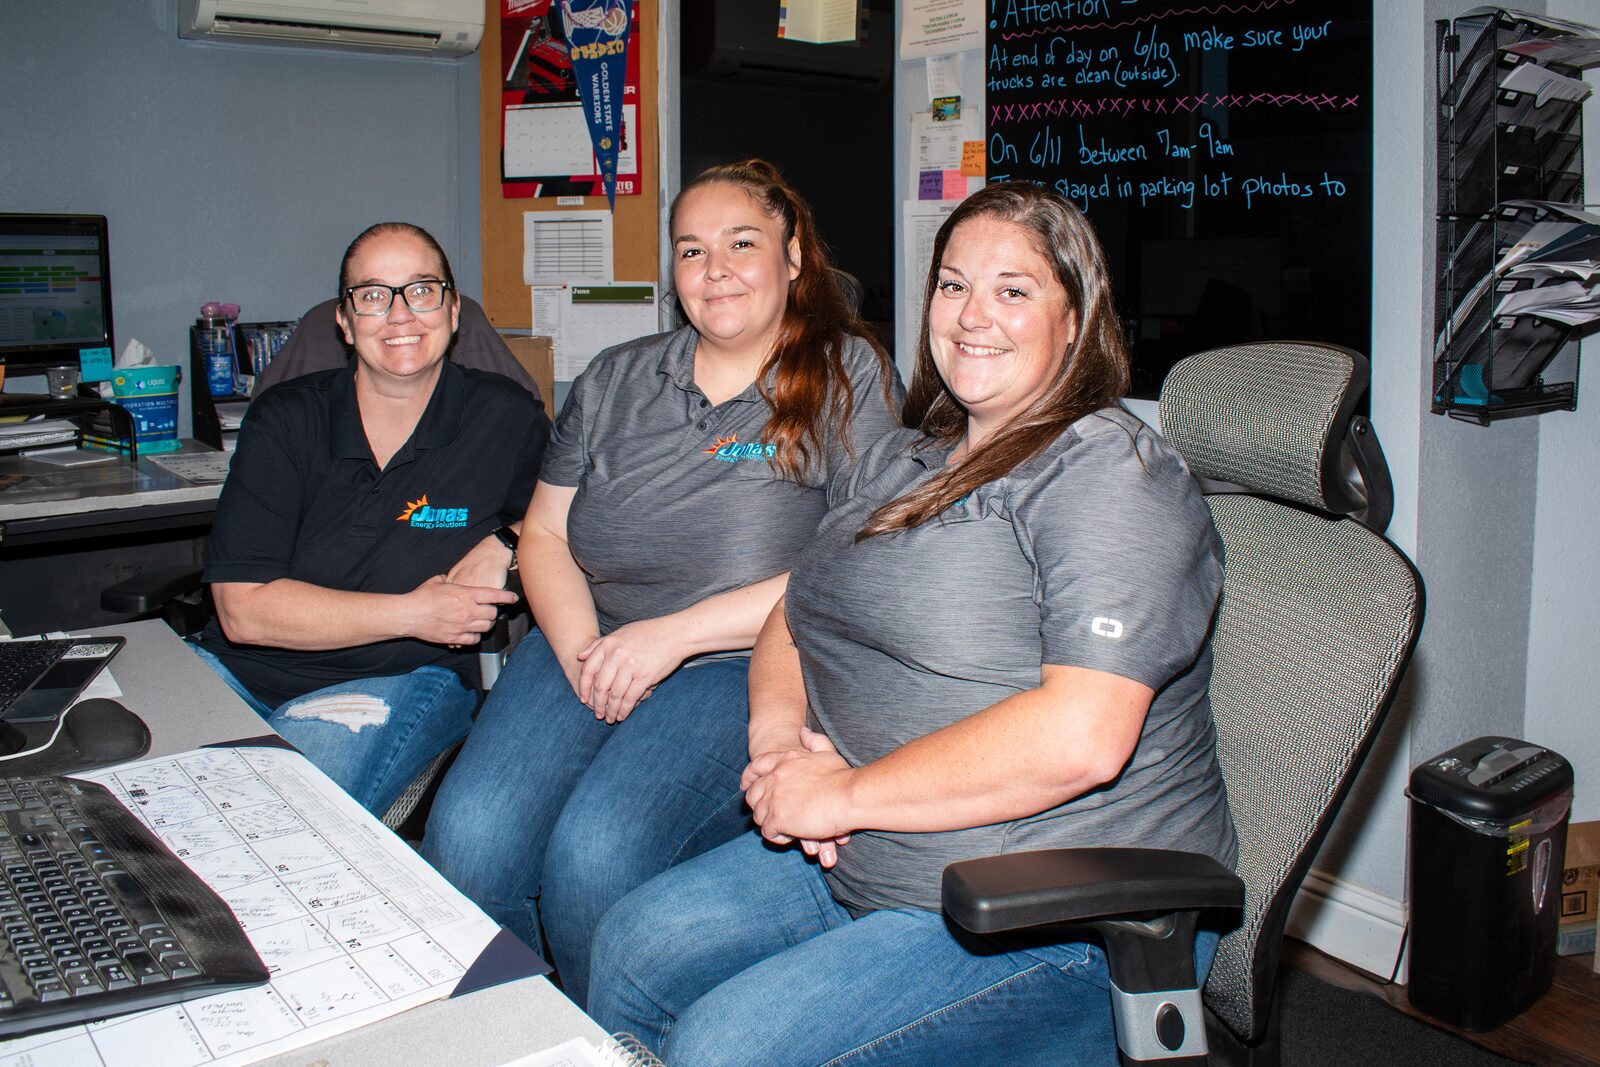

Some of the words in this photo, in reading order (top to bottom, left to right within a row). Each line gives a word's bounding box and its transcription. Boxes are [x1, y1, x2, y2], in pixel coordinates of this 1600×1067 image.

[1003, 0, 1111, 28] Attention
[989, 44, 1007, 71] At
[1012, 44, 1038, 66] end
[1045, 37, 1067, 65] of
[1066, 41, 1092, 69] day
[1100, 47, 1118, 62] on
[1134, 24, 1170, 67] 6/10
[1184, 26, 1234, 51] make
[1242, 30, 1282, 46] sure
[1292, 21, 1332, 51] your
[600, 62, 611, 102] GOLDEN
[987, 75, 1034, 92] trucks
[1041, 74, 1067, 88] are
[1075, 68, 1110, 84] clean
[591, 73, 602, 124] WARRIORS
[603, 104, 613, 131] STATE
[990, 133, 1018, 164] On
[1030, 125, 1061, 168] 6/11
[1079, 124, 1148, 165] between
[1117, 177, 1132, 197] in
[1140, 176, 1195, 208] parking
[1205, 172, 1232, 196] lot
[1242, 172, 1313, 209] photos
[1320, 172, 1346, 196] to
[410, 521, 435, 529] Energy
[411, 505, 469, 522] Jonas
